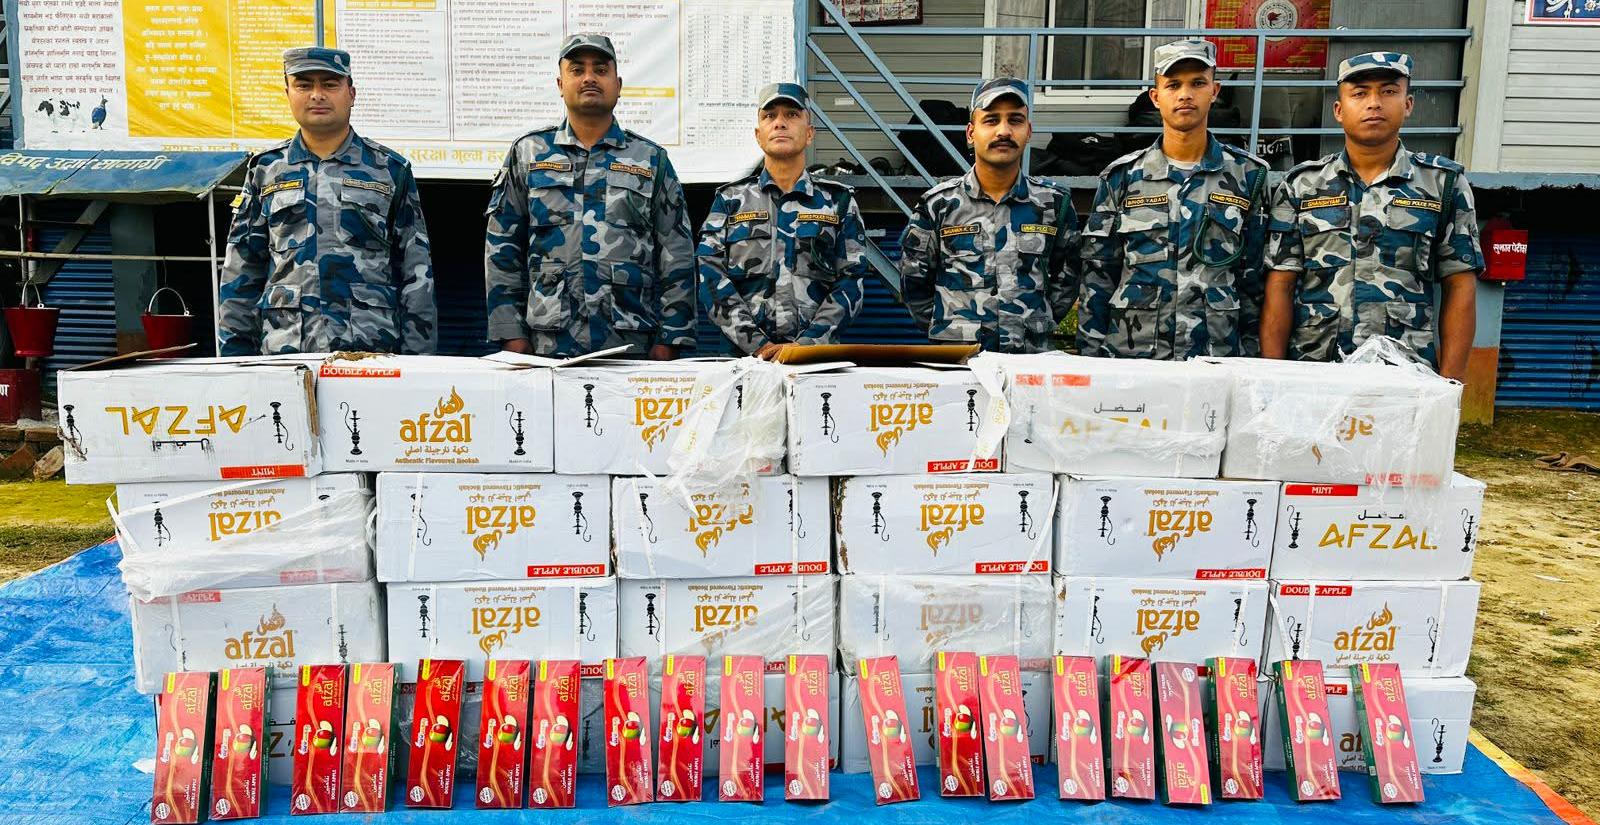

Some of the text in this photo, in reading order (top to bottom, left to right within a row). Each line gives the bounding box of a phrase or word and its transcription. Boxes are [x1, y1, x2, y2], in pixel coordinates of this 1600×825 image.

[104, 404, 249, 436] AFZAL
[399, 413, 473, 443] afzal
[870, 402, 934, 432] afzal
[251, 468, 275, 476] MINT
[932, 464, 957, 472] APPLE
[1311, 486, 1334, 495] MINT
[465, 504, 536, 535] afzal
[920, 503, 985, 532] afzal
[1148, 509, 1213, 537] afzal
[1318, 523, 1438, 550] AFZAL
[533, 566, 600, 575] DOUBLE APPLE
[760, 565, 786, 573] APPLE
[981, 564, 1007, 572] APPLE
[1285, 586, 1347, 595] DOUBE APPLE
[471, 606, 541, 635] afzal
[1136, 608, 1200, 636] afzal
[224, 629, 296, 660] afzal
[1333, 626, 1397, 652] afzal
[372, 678, 383, 705] afzal
[440, 675, 453, 702] afzal
[507, 675, 520, 702] afzal
[558, 675, 570, 702] afzal
[628, 672, 638, 698] afzal
[684, 670, 696, 696] afzal
[743, 670, 754, 696] afzal
[880, 671, 893, 696] afzal
[958, 666, 968, 692] afzal
[1000, 670, 1012, 696] afzal
[1075, 671, 1088, 697] afzal
[1237, 673, 1248, 698] afzal
[1304, 675, 1316, 700] afzal
[1383, 677, 1396, 702] afzal
[186, 687, 197, 714] afzal
[243, 683, 253, 710] afzal
[321, 680, 335, 707] afzal
